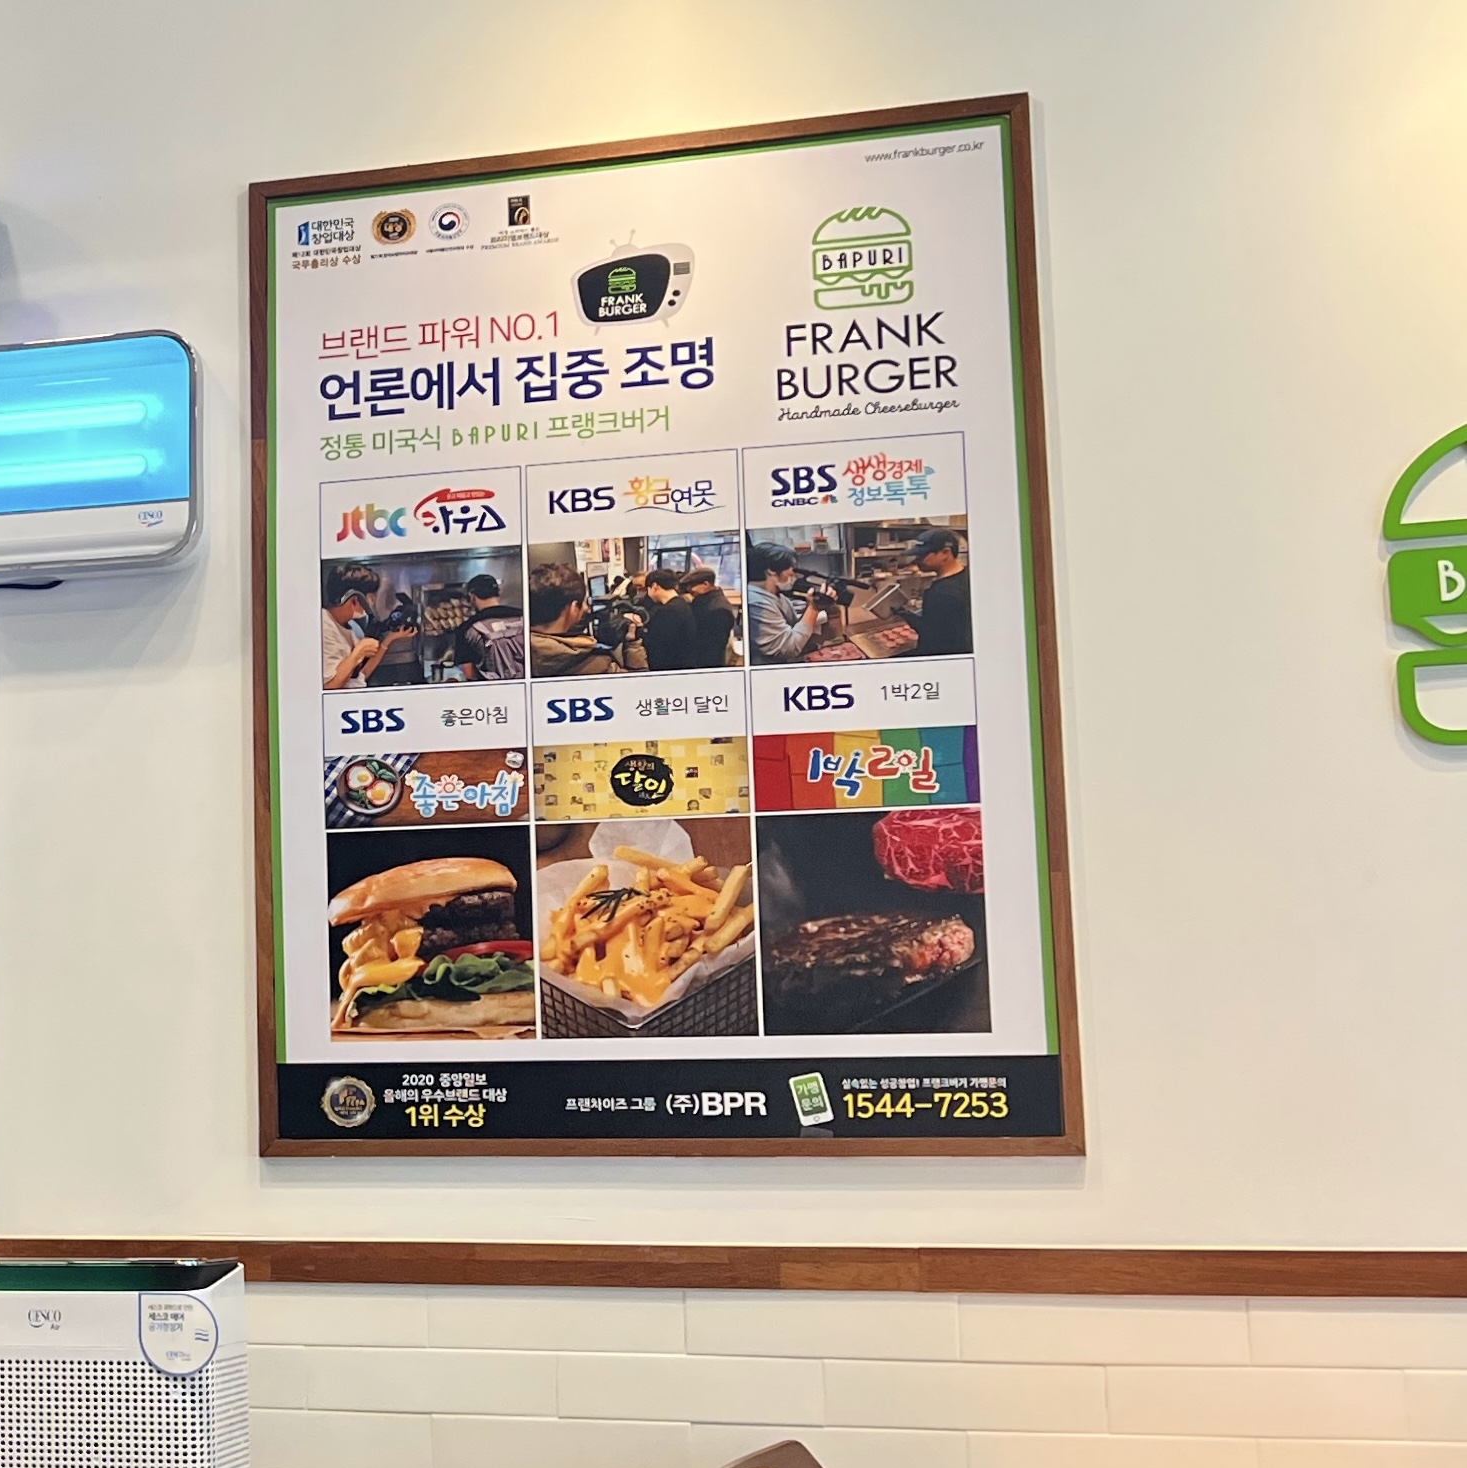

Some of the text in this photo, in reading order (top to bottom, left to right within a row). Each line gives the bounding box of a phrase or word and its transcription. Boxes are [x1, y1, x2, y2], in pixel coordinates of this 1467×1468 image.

[864, 140, 985, 163] www.frankburger.co.kr
[312, 217, 355, 232] 대한민국
[312, 230, 355, 245] 창업대상
[821, 246, 904, 272] BAPURI
[598, 302, 648, 318] BURGER
[601, 292, 644, 308] FRANK
[318, 310, 559, 361] 브랜드 파워 NO.1
[785, 310, 946, 358] FRANK
[319, 336, 716, 422] 언론에서 집중 조명
[776, 354, 959, 402] BURGER
[777, 402, 862, 422] Handmade
[319, 405, 671, 462] 정통 미국식 BAPURI 프랭크버거
[771, 452, 923, 497] SBS 생생경제
[548, 475, 717, 516] KBS 황금연못
[771, 496, 819, 507] CNBC
[847, 474, 932, 507] 정보톡톡
[336, 502, 408, 544] jtbc
[546, 694, 729, 725] SBS 생활의 달인
[783, 680, 941, 712] KBS 1박2일
[340, 705, 509, 735] SBS 좋은아침
[408, 769, 523, 818] 좋은아침
[402, 1072, 488, 1088] 2020 중앙일보
[921, 1077, 969, 1089] 프랭크버거
[969, 1076, 1007, 1089] 가맹문의
[383, 1088, 420, 1103] 올해의
[420, 1088, 482, 1103] 우수브랜드
[482, 1087, 508, 1103] 대상
[564, 1091, 768, 1117] 프랜차이즈 그룹 (주)BPR
[842, 1091, 1010, 1119] 1544-7253
[404, 1103, 487, 1128] 1위 수상
